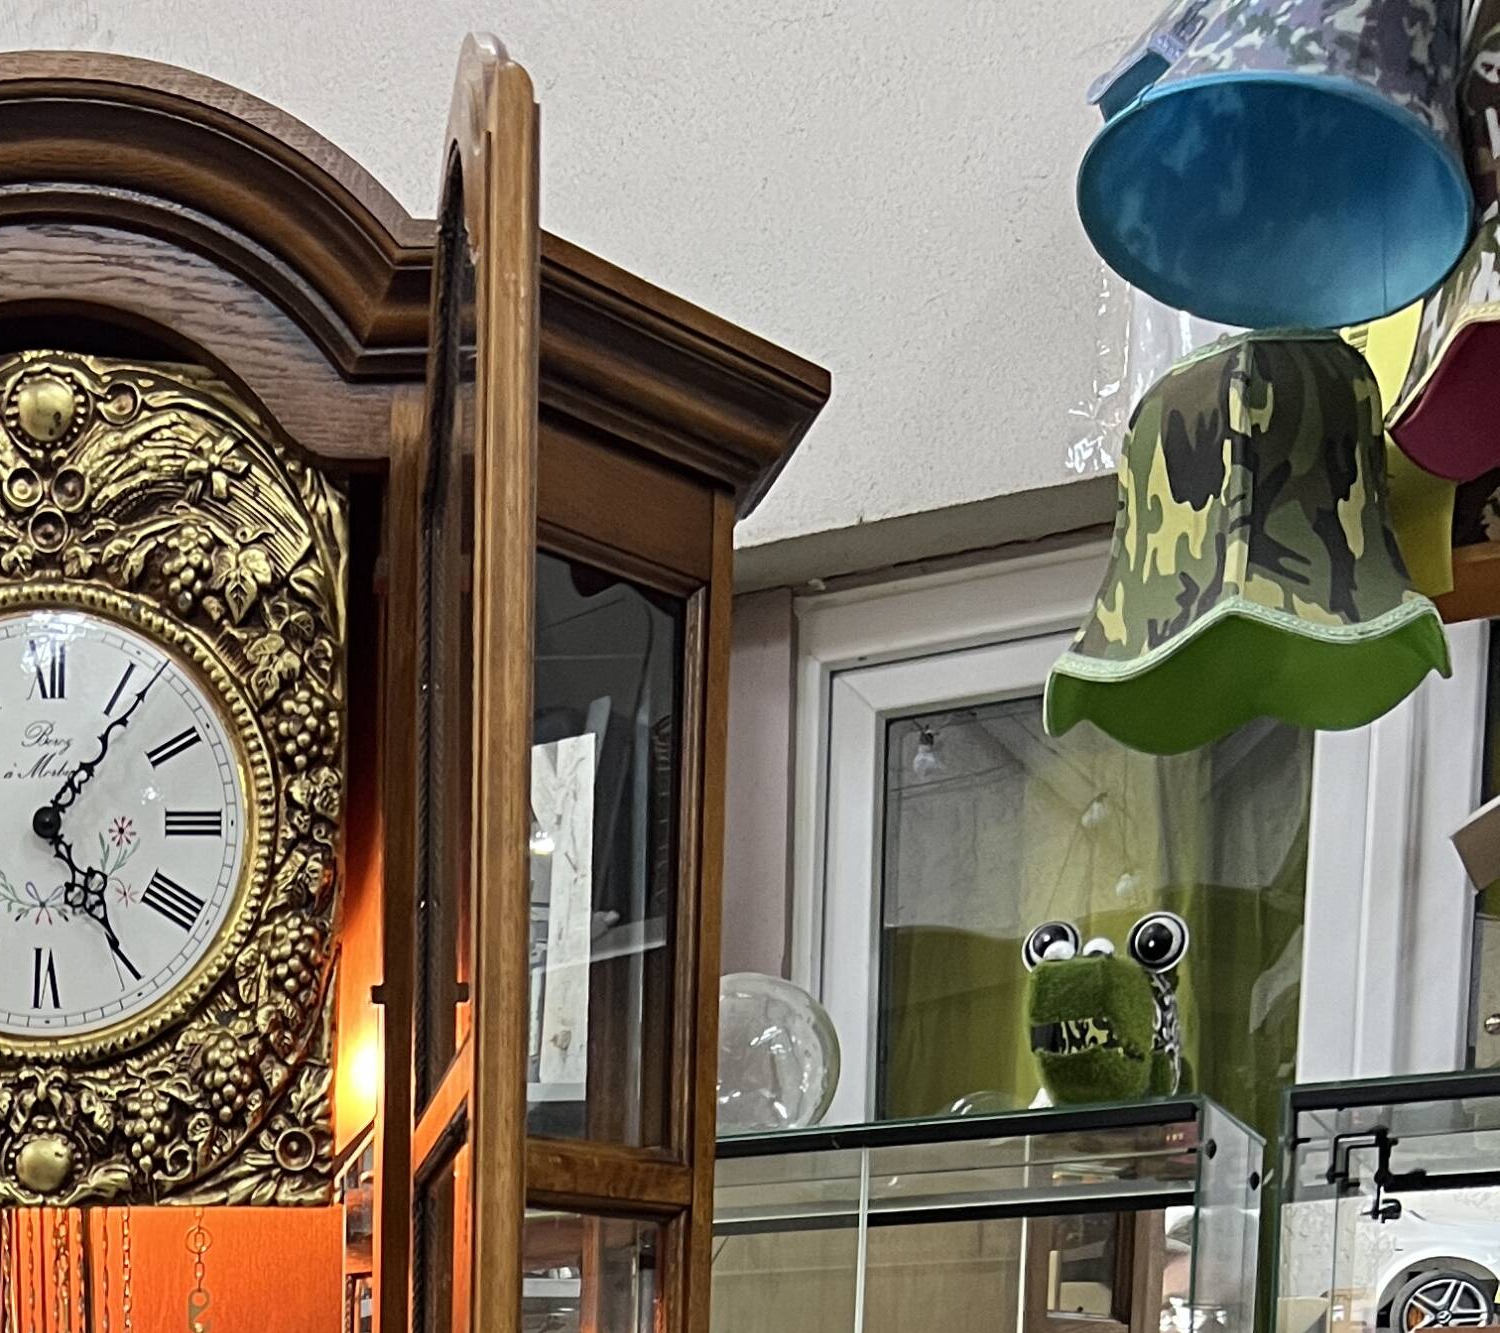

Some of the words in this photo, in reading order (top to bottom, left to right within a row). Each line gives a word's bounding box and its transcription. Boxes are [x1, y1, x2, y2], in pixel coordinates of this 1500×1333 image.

[26, 640, 67, 700] XII
[103, 661, 136, 717] I
[145, 725, 202, 770] II
[164, 808, 222, 838] III
[31, 947, 62, 1010] VI
